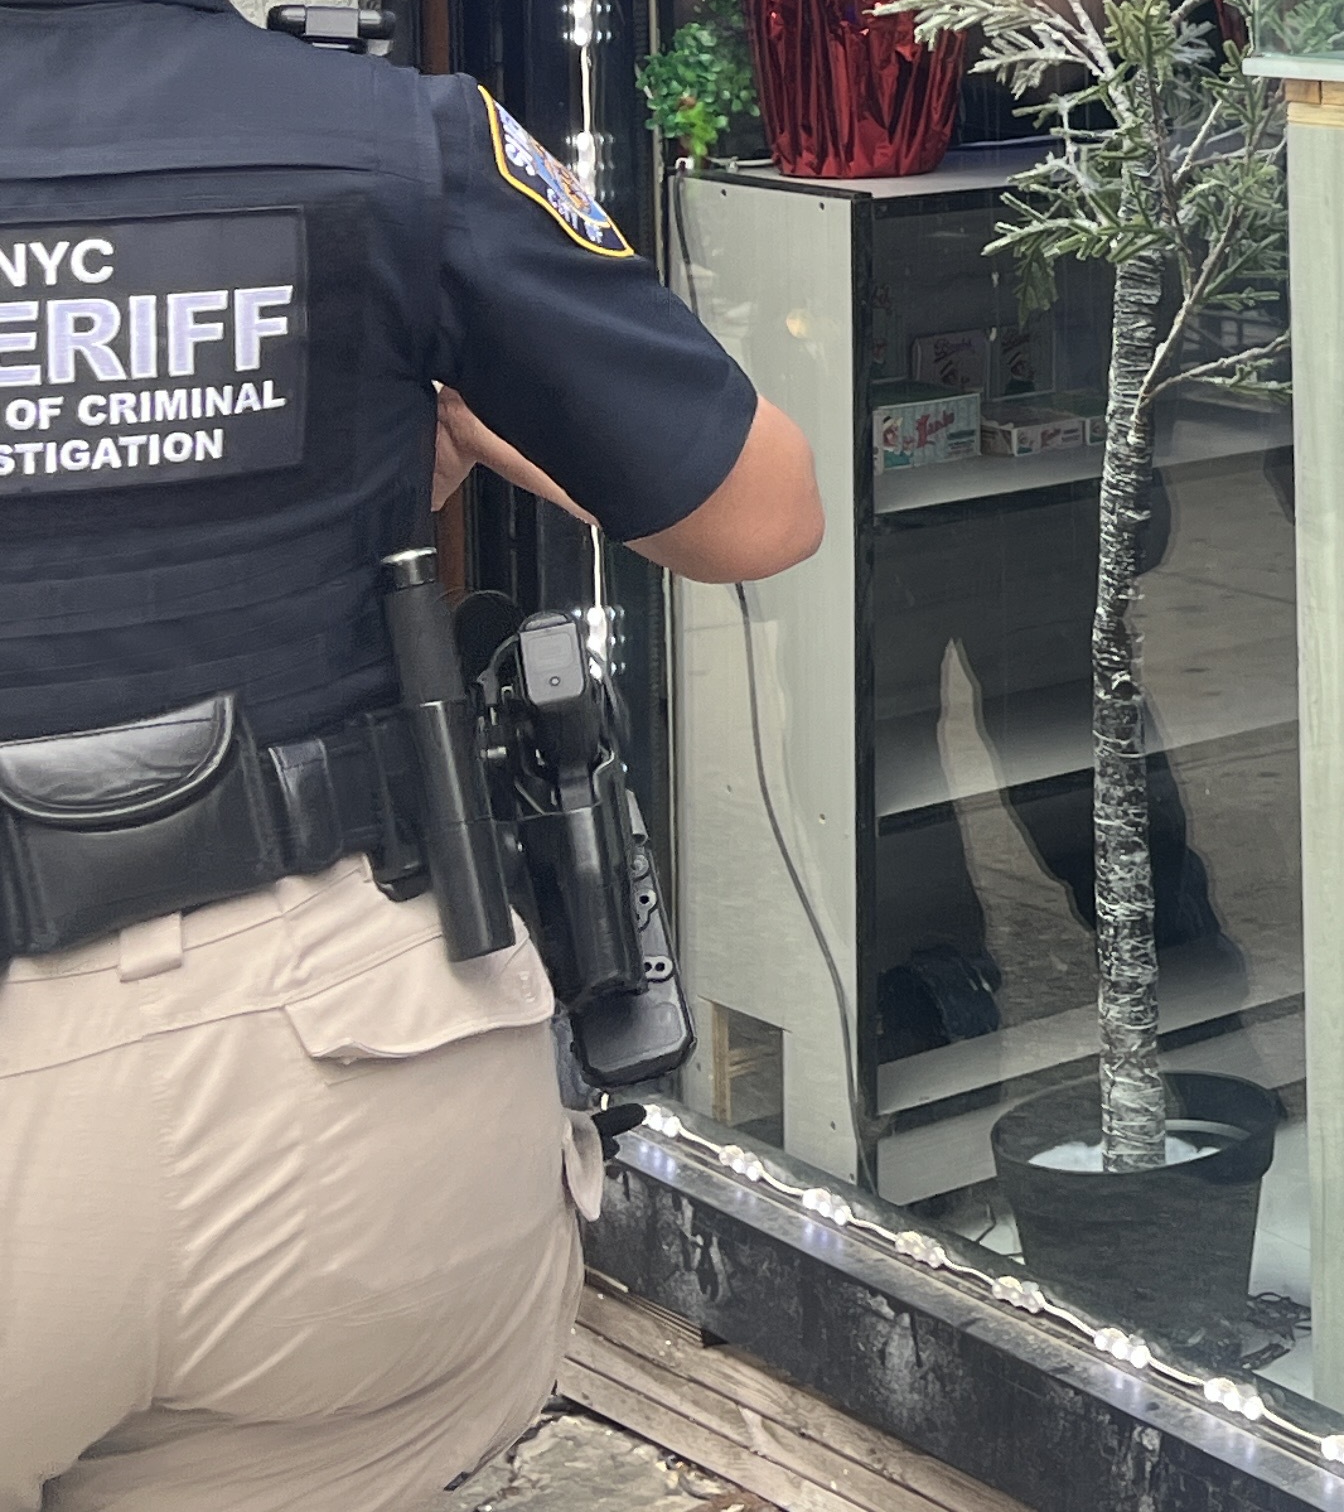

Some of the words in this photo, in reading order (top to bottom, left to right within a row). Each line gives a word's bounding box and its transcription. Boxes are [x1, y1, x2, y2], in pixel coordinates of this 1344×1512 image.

[0, 239, 114, 287] NYC
[5, 396, 64, 431] OF
[77, 380, 287, 426] CRIMINAL
